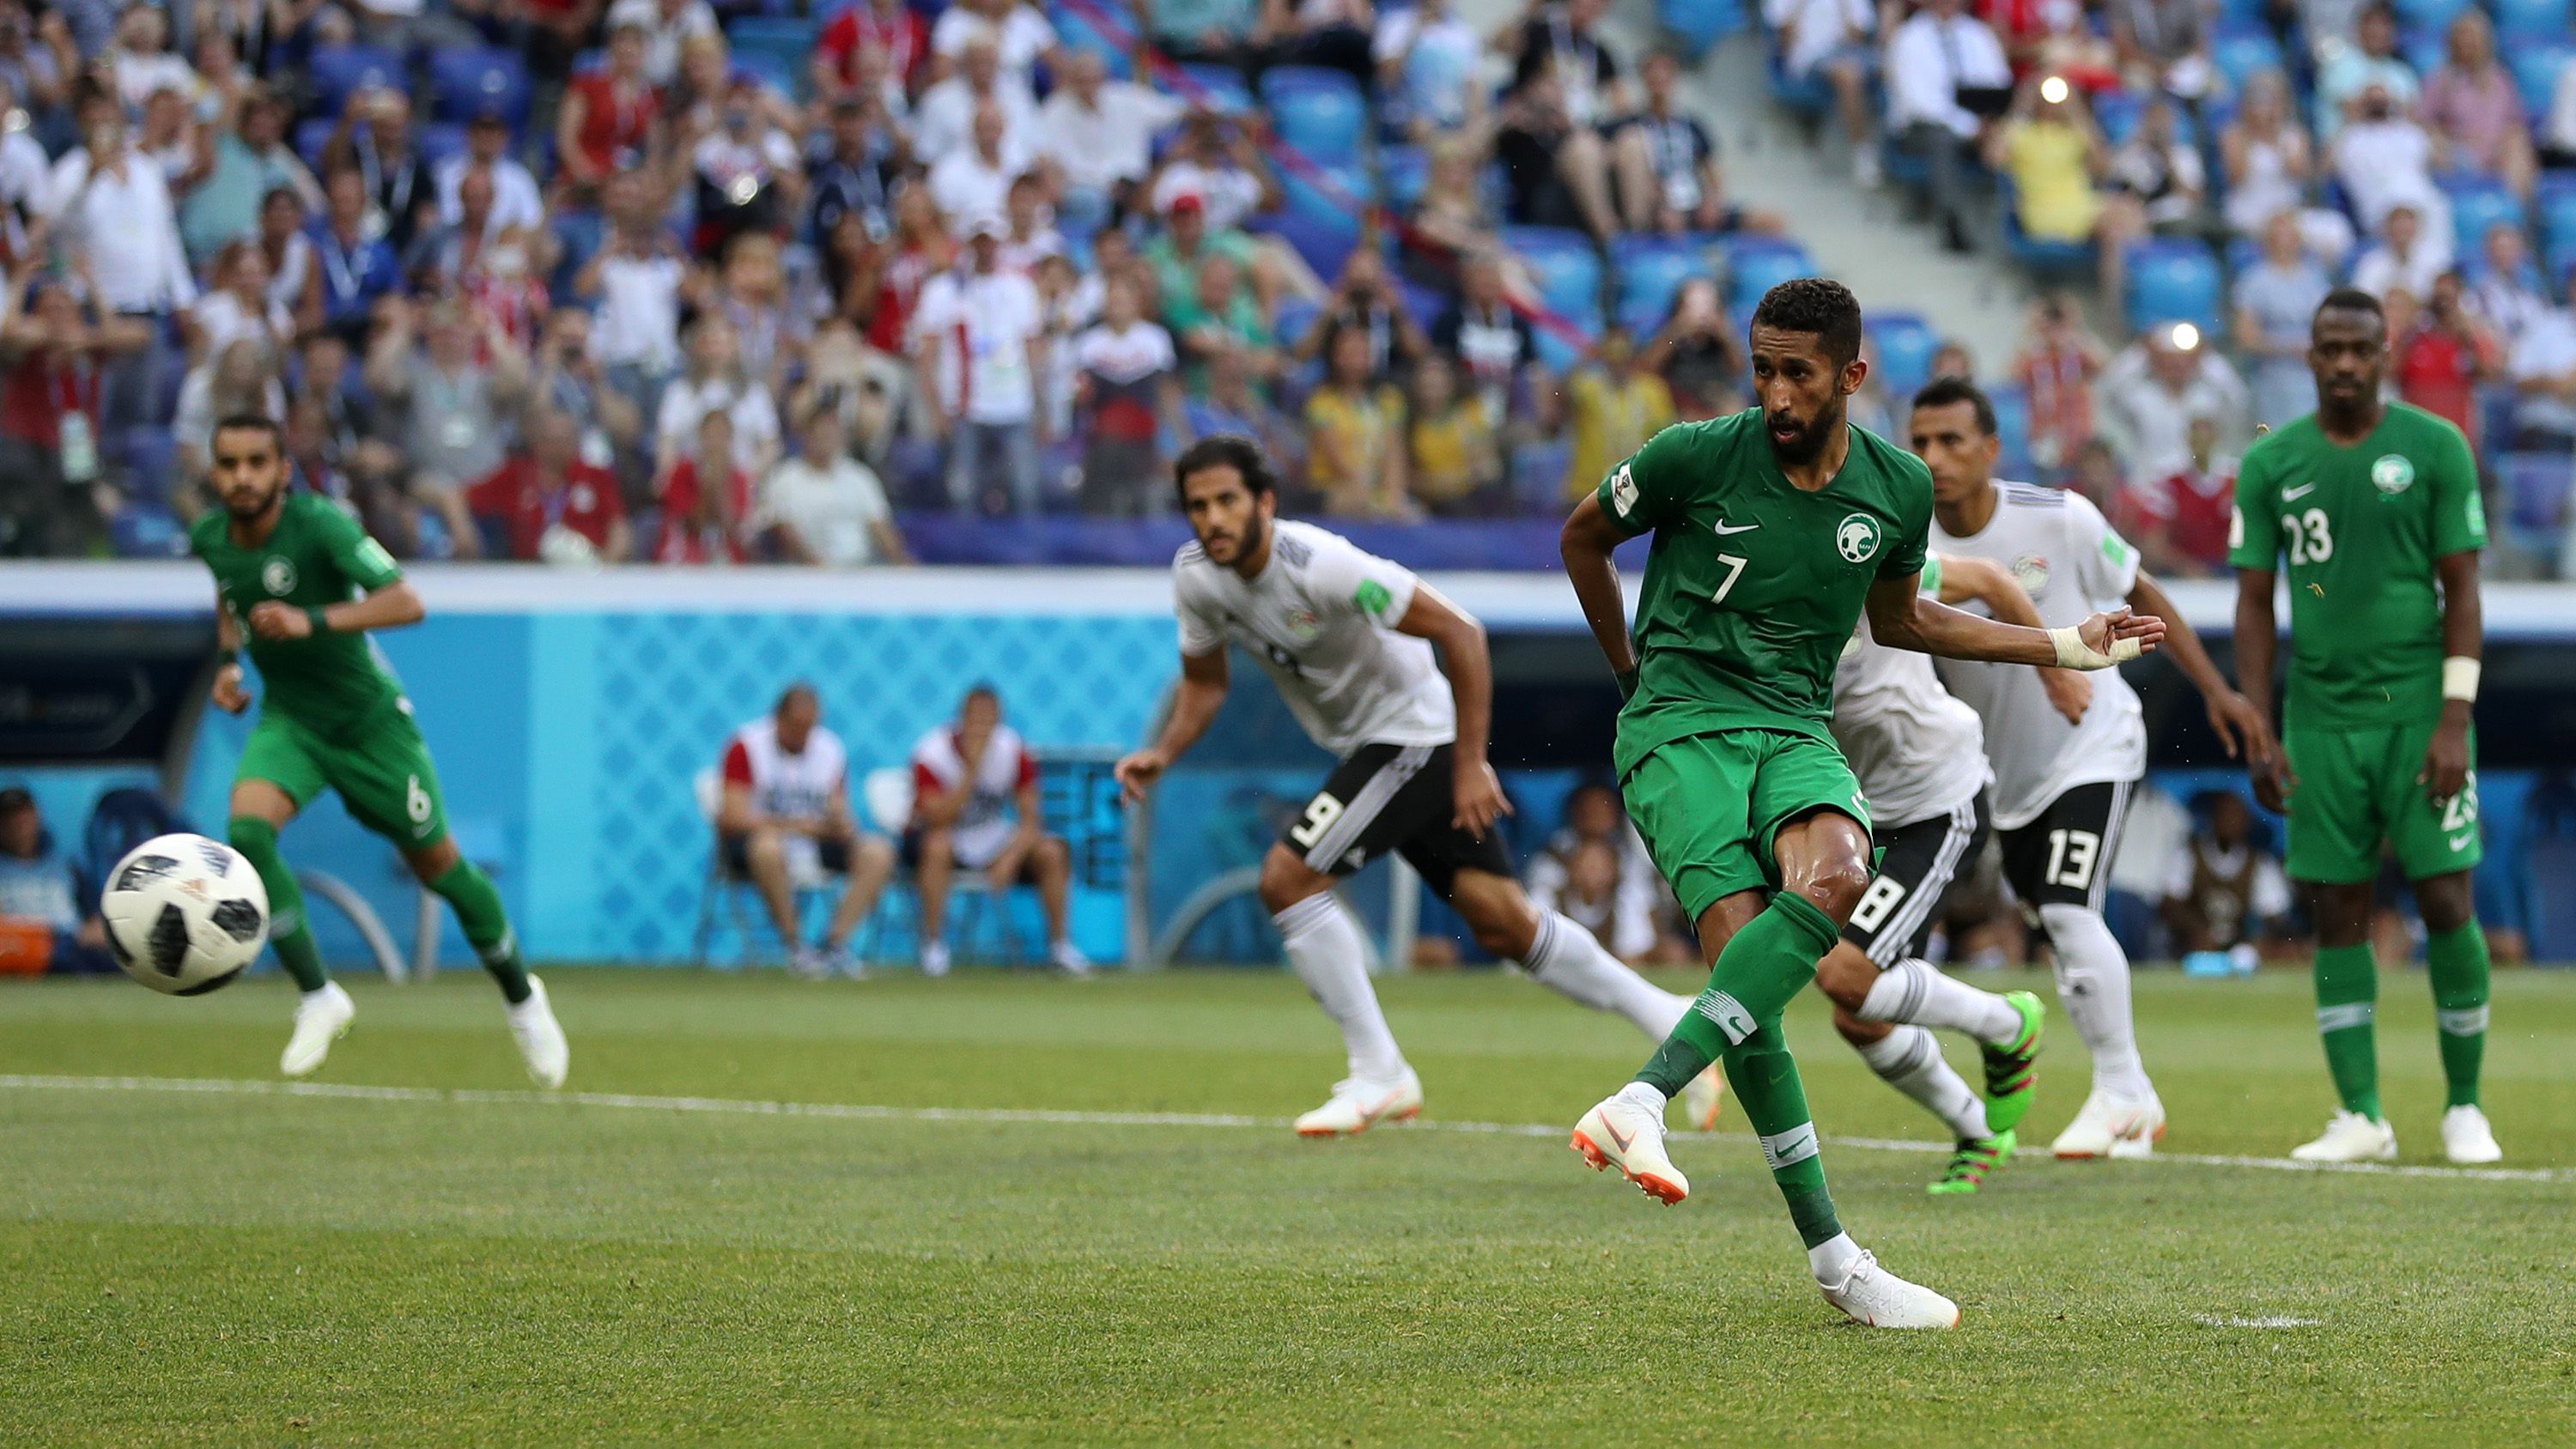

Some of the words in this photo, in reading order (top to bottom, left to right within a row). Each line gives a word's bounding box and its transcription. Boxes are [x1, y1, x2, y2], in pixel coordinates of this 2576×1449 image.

[2281, 507, 2334, 566] 23
[1710, 553, 1748, 604] 7
[406, 773, 433, 823] 6
[1291, 790, 1345, 849] 9
[2045, 828, 2100, 890] 13
[1849, 874, 1906, 934] 8
